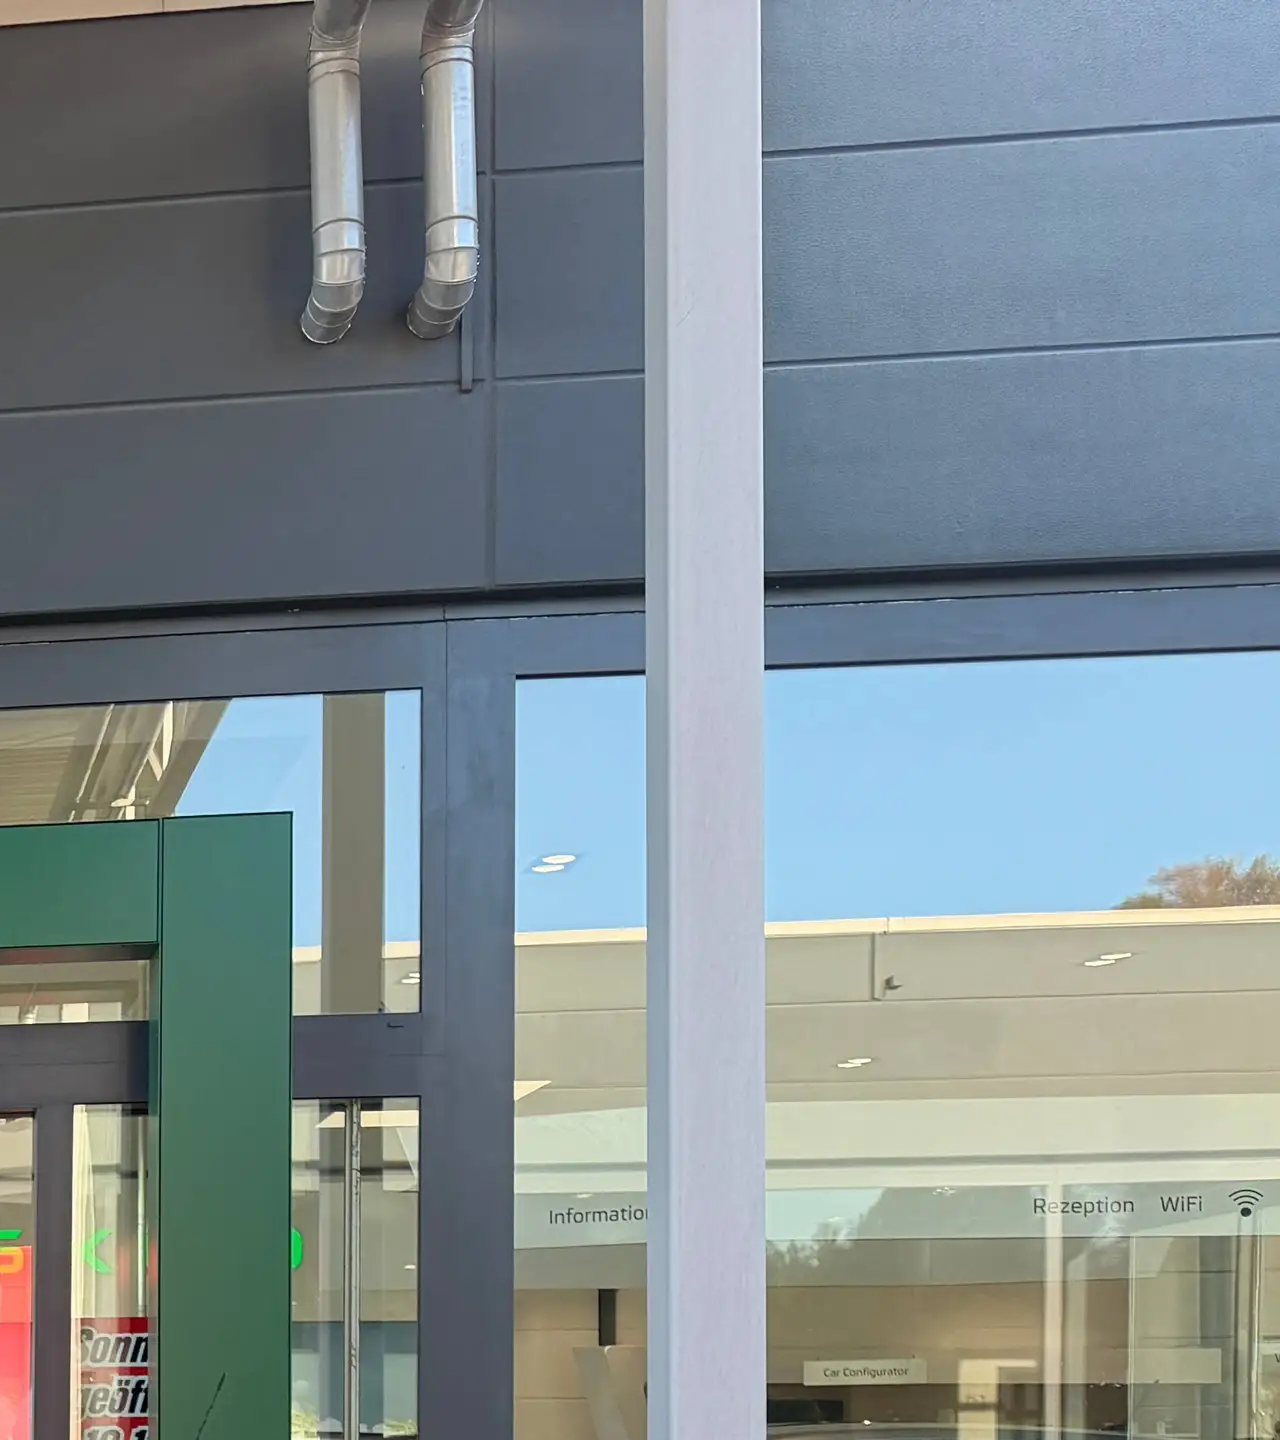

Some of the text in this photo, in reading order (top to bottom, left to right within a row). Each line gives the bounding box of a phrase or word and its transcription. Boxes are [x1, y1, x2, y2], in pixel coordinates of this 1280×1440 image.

[549, 1205, 649, 1225] Informatio
[1033, 1195, 1202, 1217] Rezeption WiFi
[823, 1366, 910, 1379] Car Configurator
